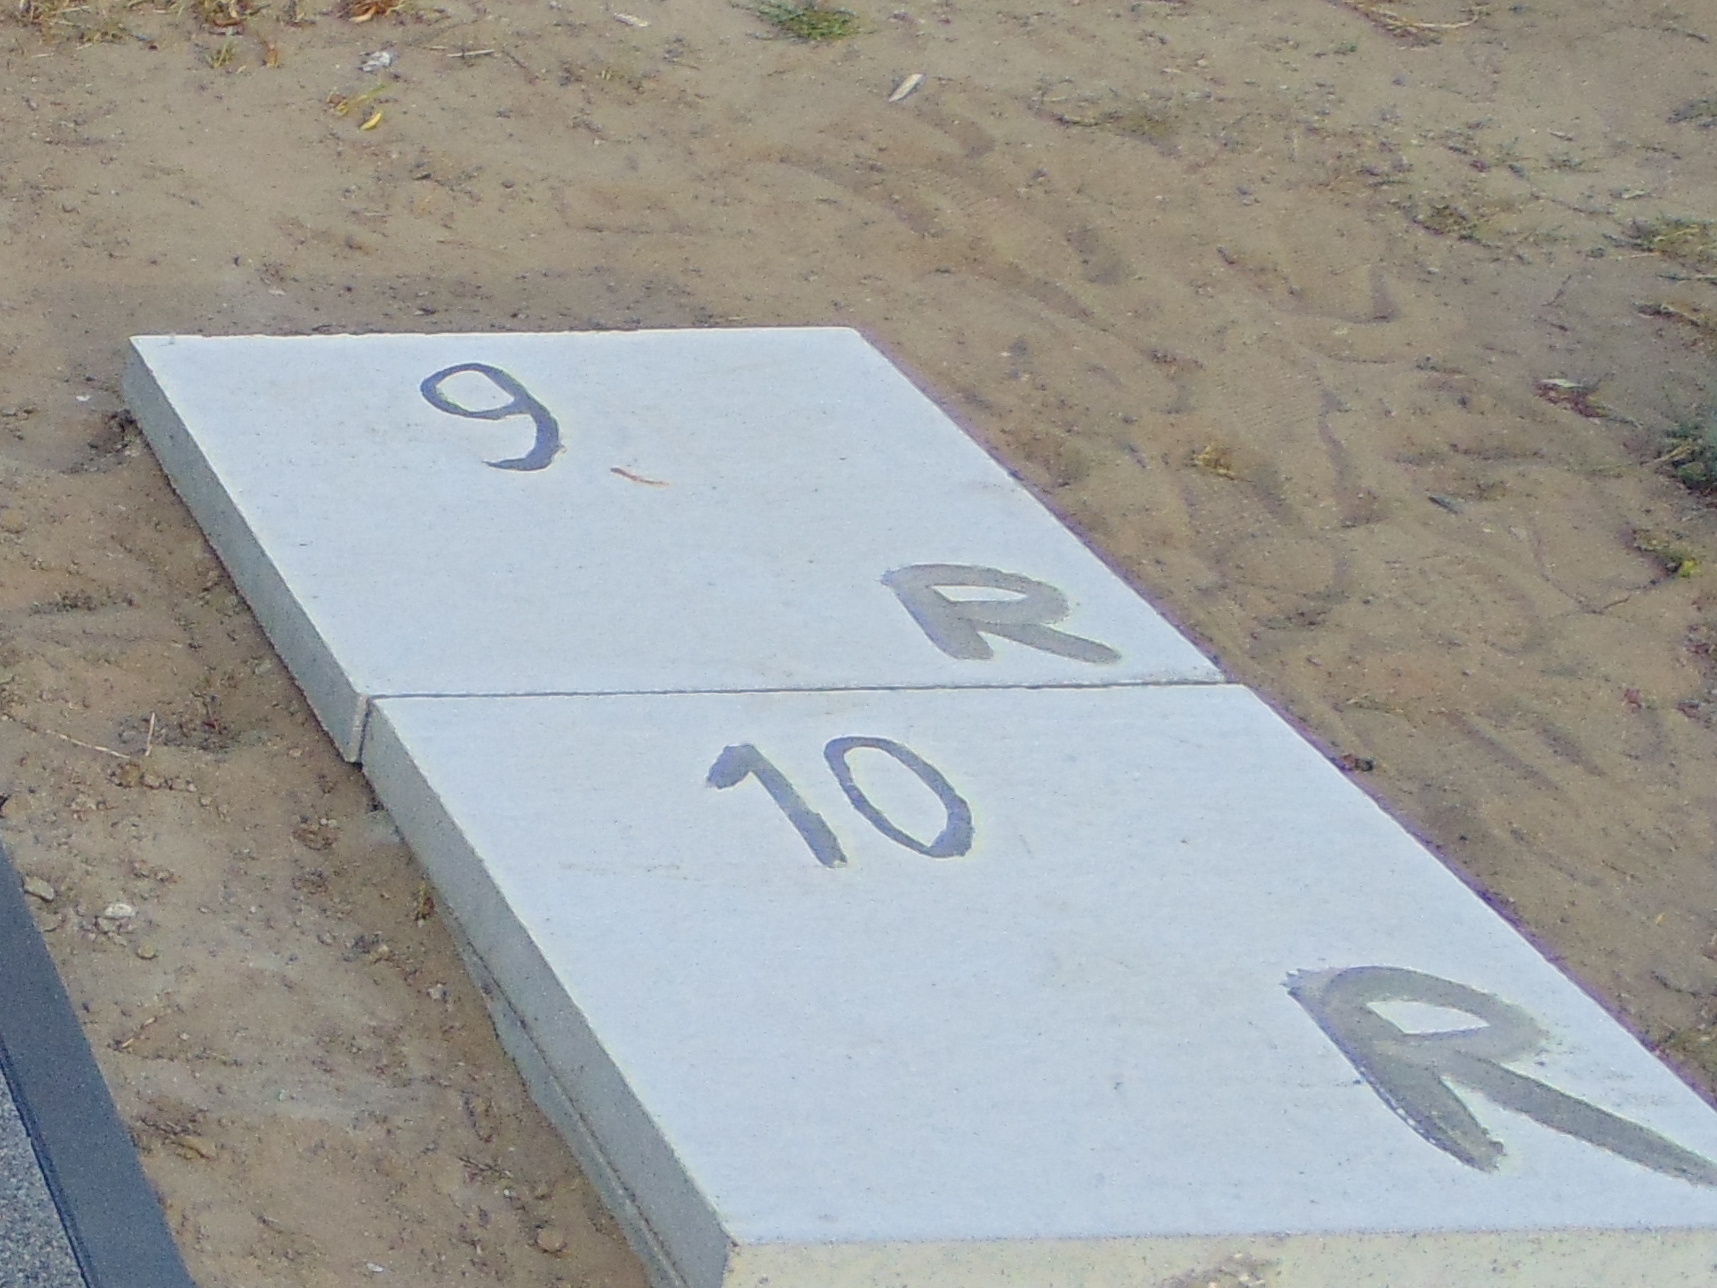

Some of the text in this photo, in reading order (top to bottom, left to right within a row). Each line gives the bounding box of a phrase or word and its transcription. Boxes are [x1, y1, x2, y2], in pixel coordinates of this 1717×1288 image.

[417, 361, 562, 472] 9
[878, 562, 1123, 662] R
[706, 734, 977, 868] 10
[1282, 964, 1717, 1190] R
